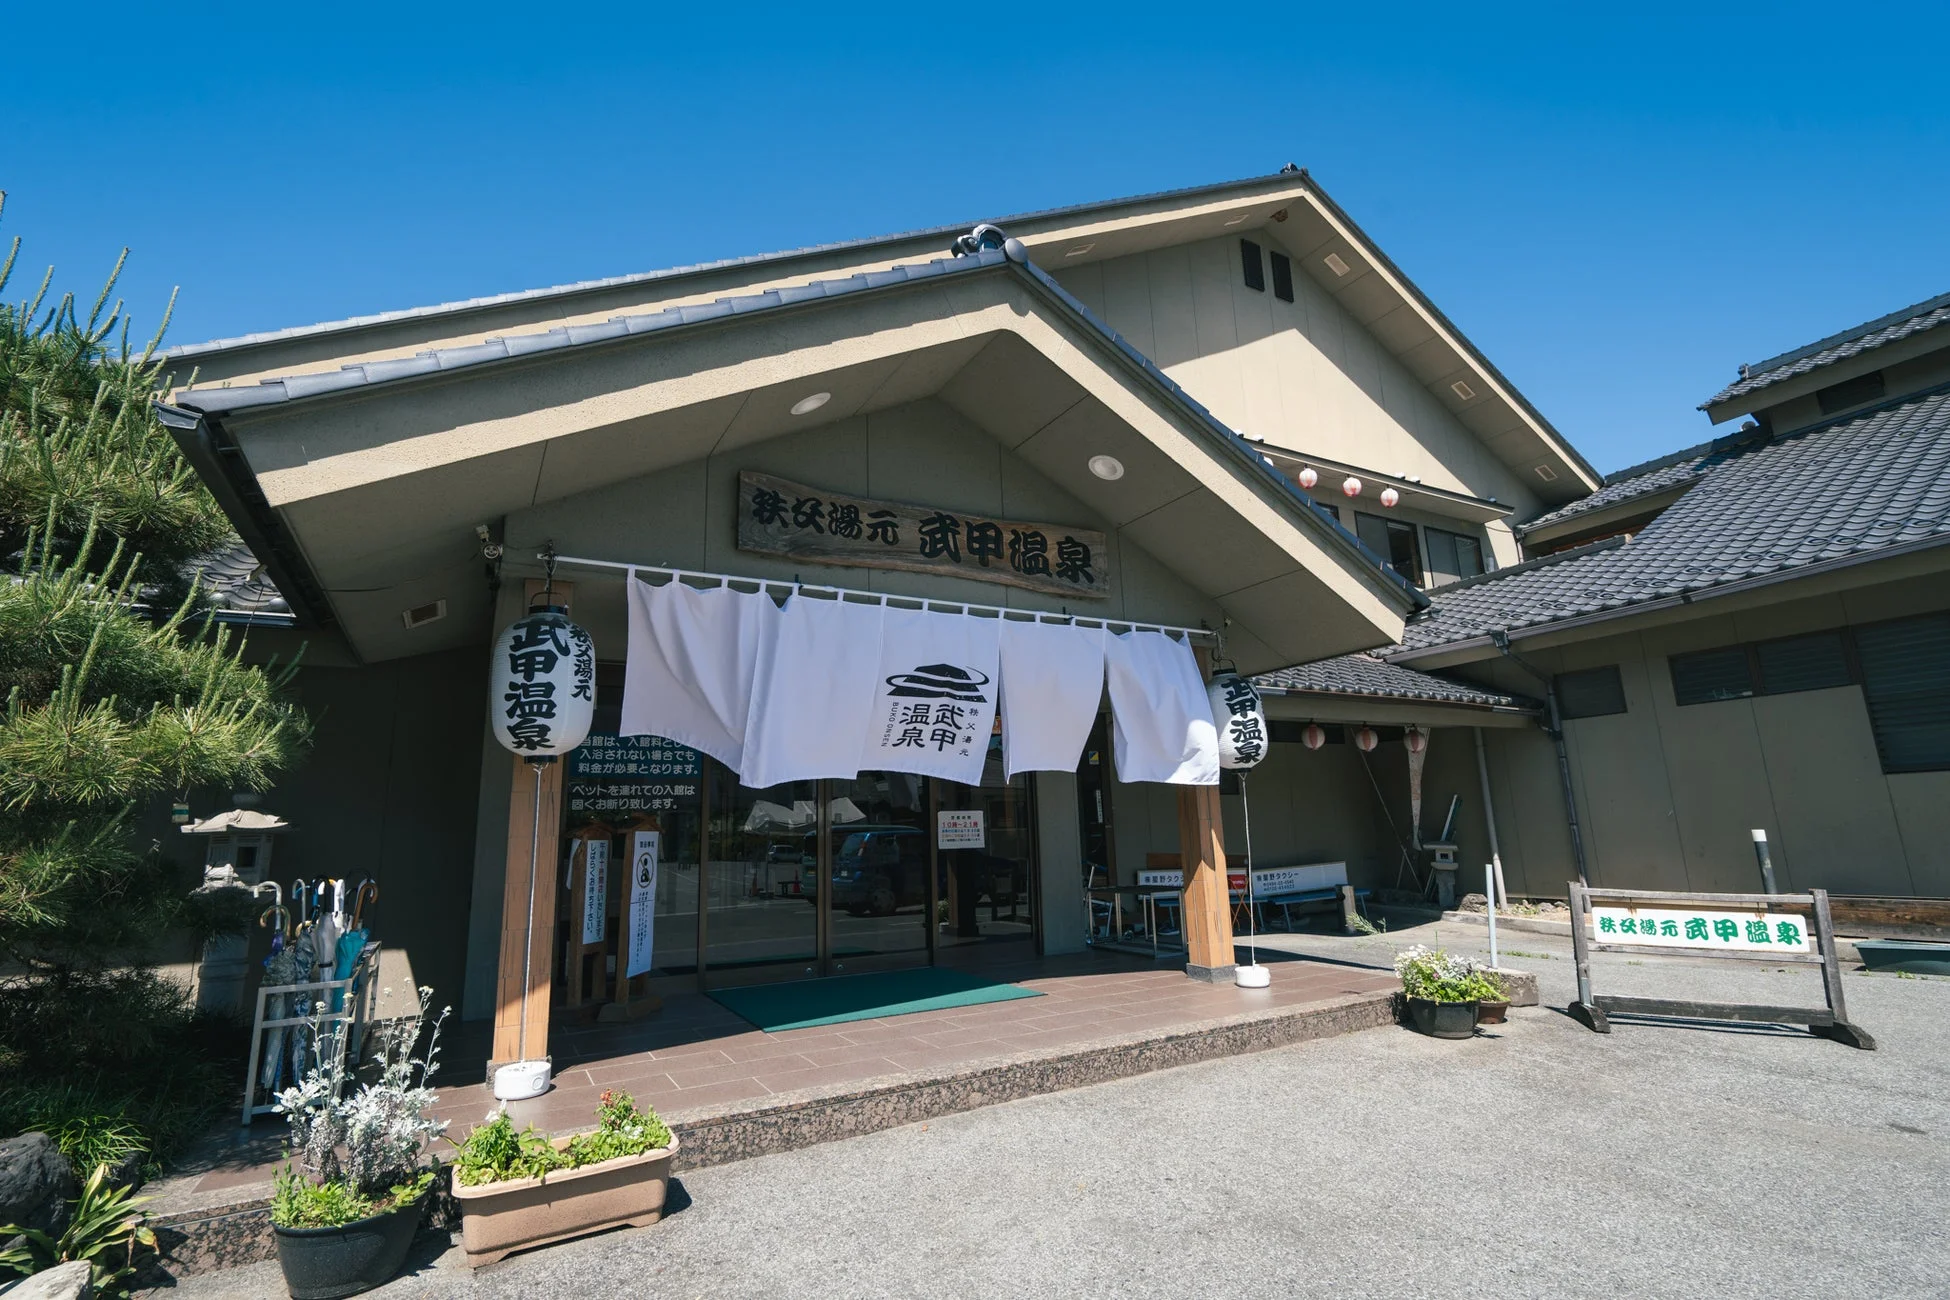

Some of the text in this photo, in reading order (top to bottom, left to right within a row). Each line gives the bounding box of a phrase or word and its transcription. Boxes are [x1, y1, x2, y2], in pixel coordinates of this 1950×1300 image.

[751, 488, 1095, 584] 秩父湯元 武甲温泉
[504, 617, 571, 750] 武甲温泉
[1220, 677, 1264, 764] 武甲温泉
[578, 762, 699, 775] 料金が必要となります。
[579, 748, 696, 761] 入浴されない場合でも
[571, 797, 679, 811] 固くお断り致します。
